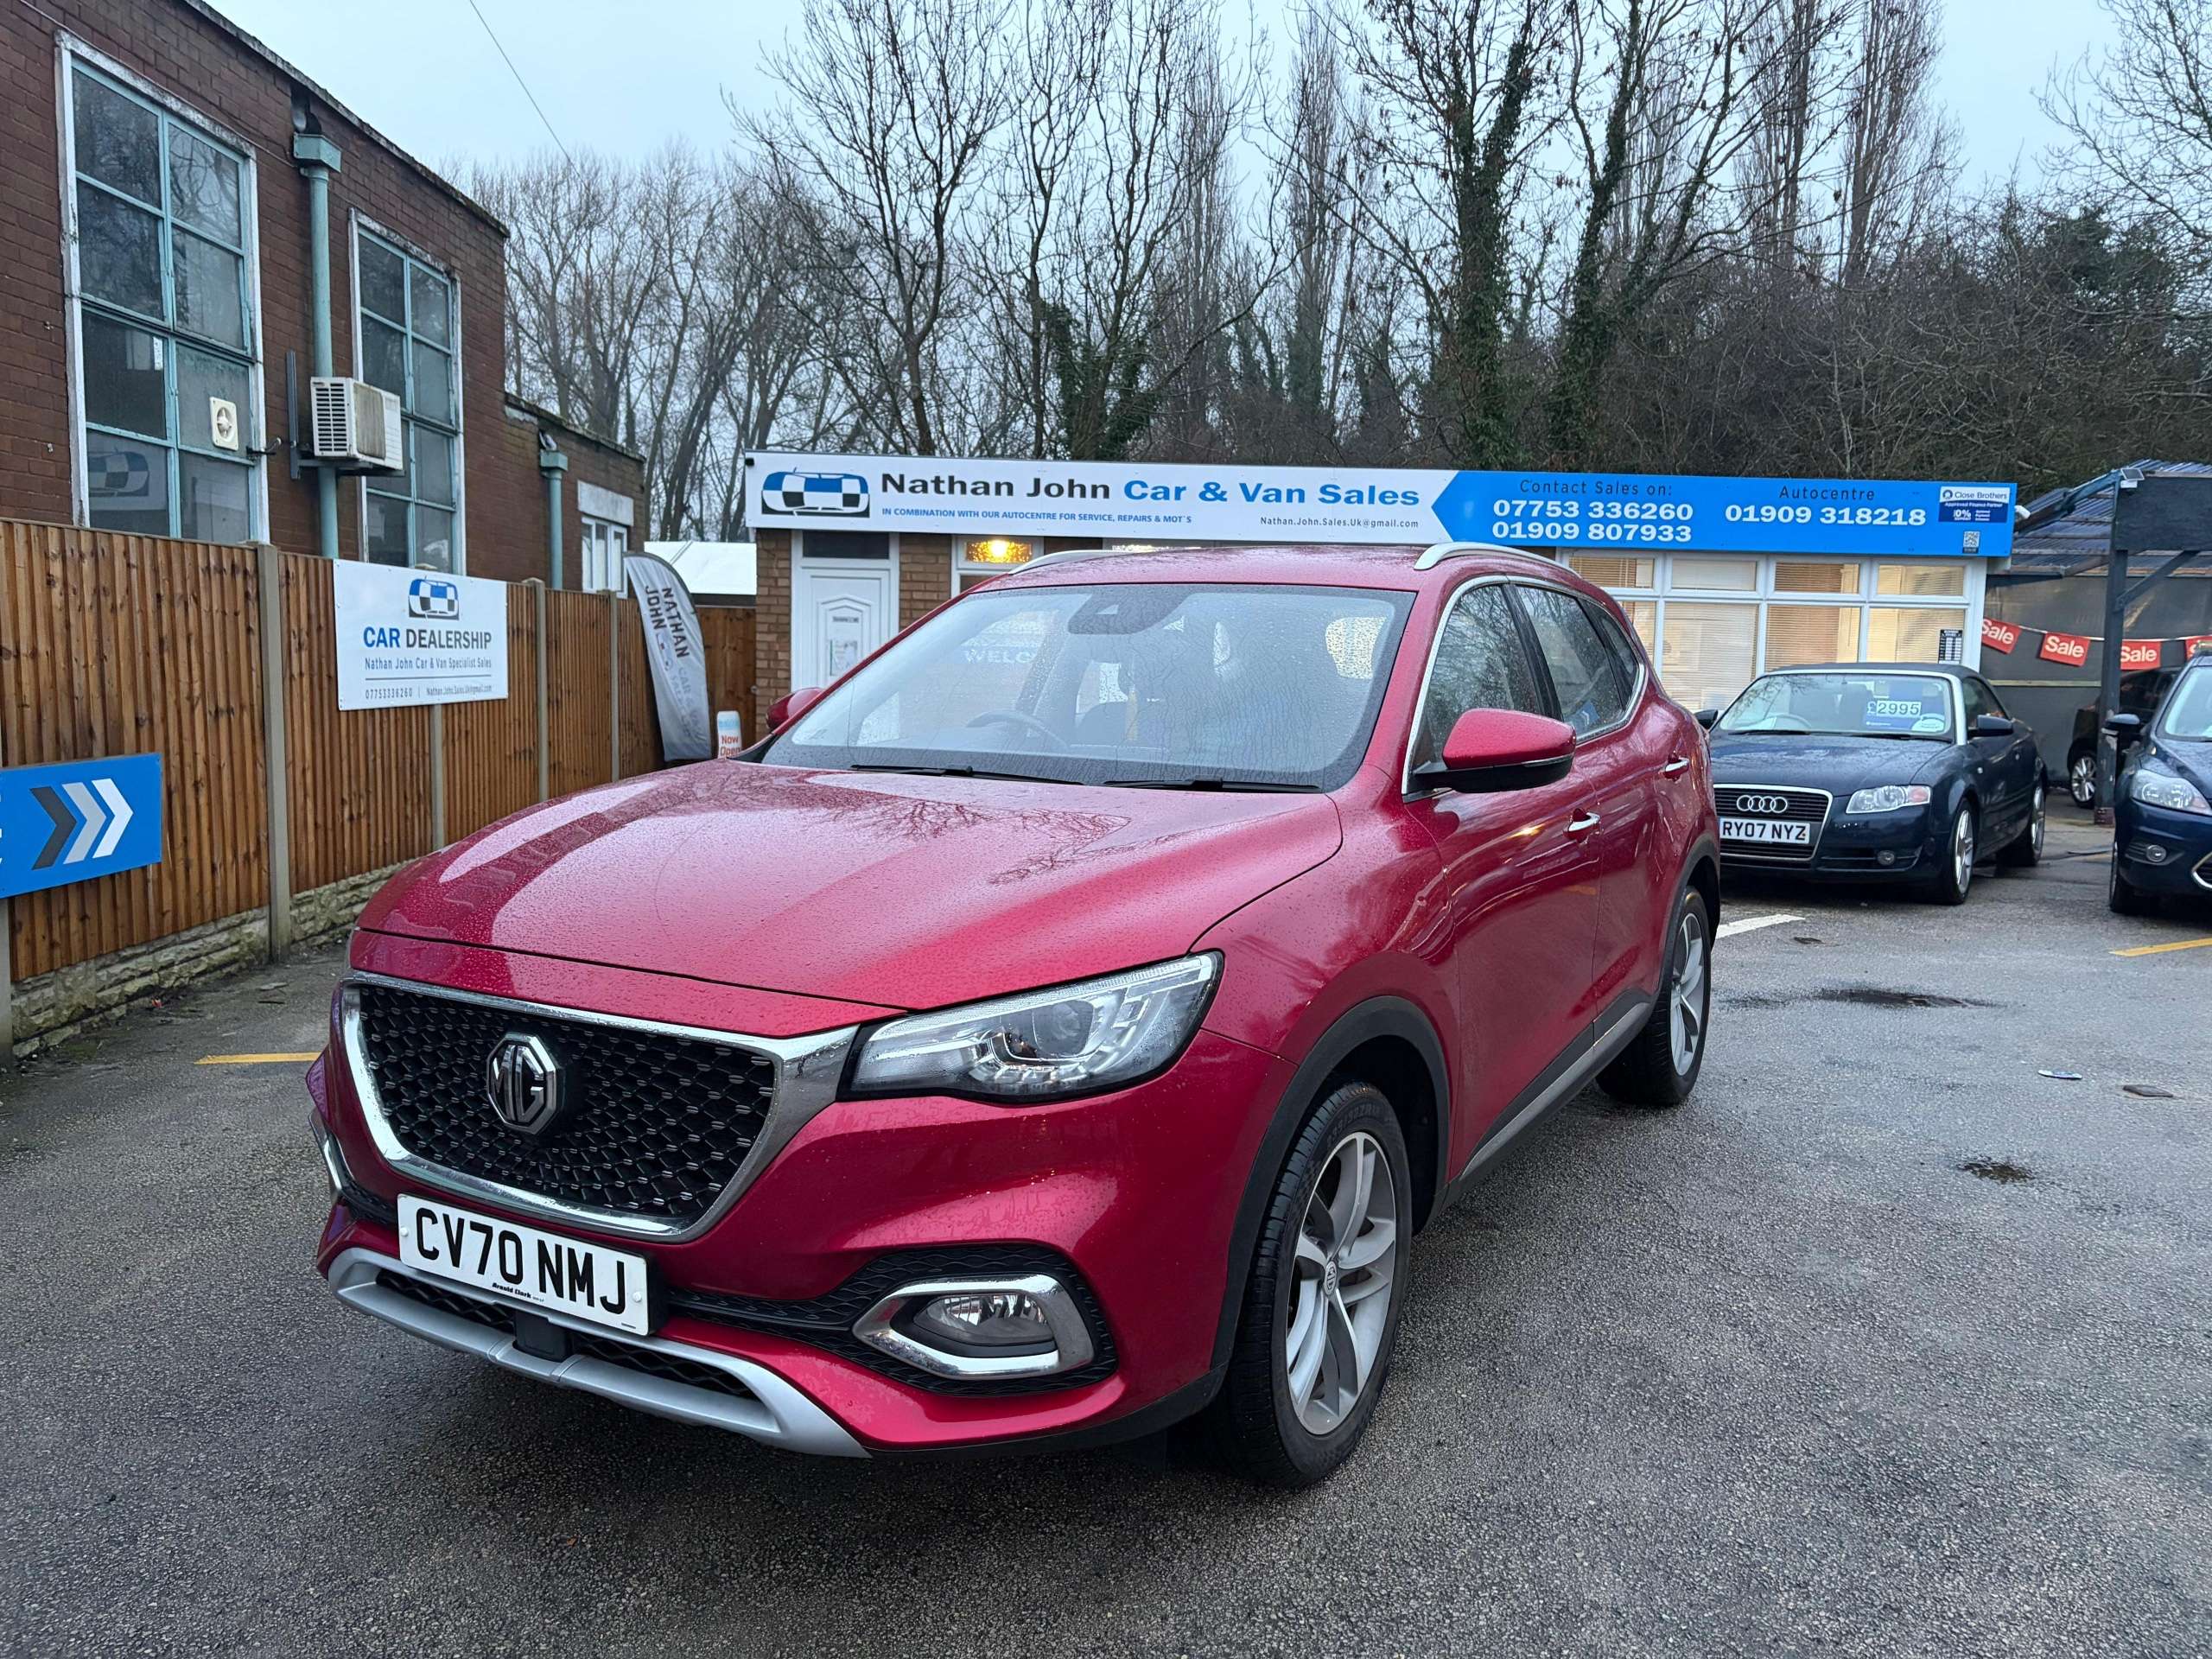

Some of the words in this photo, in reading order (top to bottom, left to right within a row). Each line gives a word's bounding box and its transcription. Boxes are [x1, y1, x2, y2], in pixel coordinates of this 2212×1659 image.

[881, 474, 1014, 497] Nathan
[1027, 477, 1110, 499] John
[1123, 480, 1187, 501] Car
[1198, 481, 1228, 503] &
[1239, 482, 1306, 504] Van
[1318, 484, 1421, 506] Sales
[1520, 479, 1587, 495] Contact
[1594, 480, 1639, 495] Sales
[1647, 484, 1673, 496] on:
[1779, 486, 1875, 501] Autocentre
[893, 508, 956, 518] COMBINATION
[957, 510, 980, 518] WITH
[1001, 511, 1057, 519] AUTOCENTRE
[1078, 513, 1116, 522] SERVICE,
[1117, 514, 1153, 523] REPAIRS
[1493, 499, 1580, 518] 07753
[1587, 501, 1694, 520] 336260
[1725, 505, 1812, 524] 01909
[1820, 506, 1927, 526] 318218
[1260, 516, 1419, 528] Nathan.John.Sales.Uk@gmail.com
[1492, 521, 1580, 540] 01909
[1587, 524, 1692, 543] 807933
[645, 585, 667, 631] JOHN
[662, 587, 690, 658] NATHAN
[1981, 619, 2015, 645] Sale
[364, 626, 401, 648] CAR
[406, 628, 492, 649] DEALERSHIP
[2044, 636, 2085, 658] Sale
[365, 658, 392, 670] Nathan
[395, 657, 413, 670] John
[416, 658, 428, 669] Car
[435, 658, 447, 668] Van
[448, 657, 476, 670] Specialist
[477, 657, 492, 668] Sales
[2120, 645, 2158, 663] Sale
[1866, 701, 1920, 715] £2995
[721, 734, 739, 745] Now
[720, 746, 741, 757] Open
[1722, 821, 1766, 838] RY07
[1771, 823, 1807, 841] NYZ
[490, 1040, 547, 1125] MG
[416, 1207, 524, 1285] CV70
[537, 1238, 626, 1315] NMJ
[492, 1282, 514, 1294] Arnold
[514, 1288, 532, 1299] Clark
